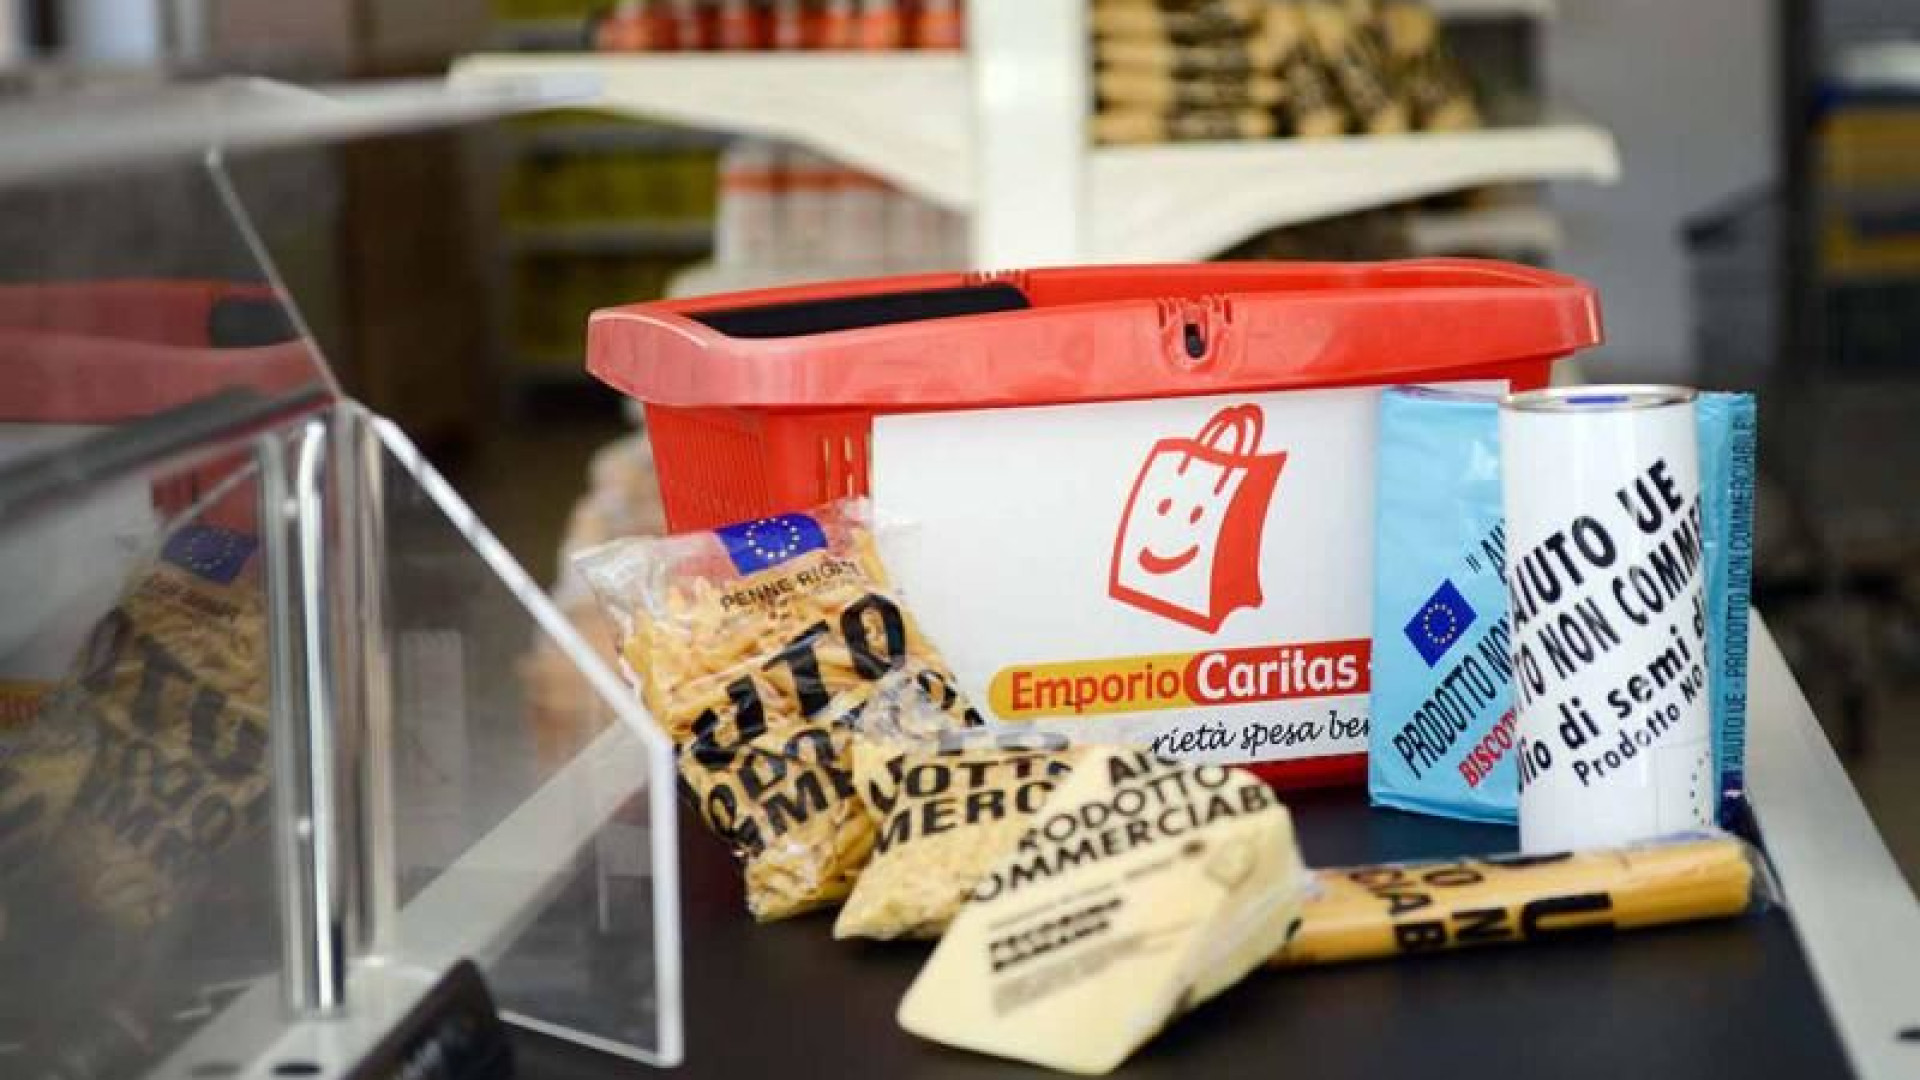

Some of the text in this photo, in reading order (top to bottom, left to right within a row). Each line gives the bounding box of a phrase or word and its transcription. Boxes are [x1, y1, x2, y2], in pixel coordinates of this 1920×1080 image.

[1510, 457, 1683, 633] AIUTO UE
[690, 592, 907, 770] UTO
[1011, 662, 1181, 714] Emporio
[1197, 649, 1360, 700] Caritas
[1536, 596, 1621, 680] NON
[1392, 653, 1497, 780] PRODOTTO
[1559, 696, 1601, 751] di
[1607, 623, 1691, 721] semi
[1240, 719, 1325, 757] spesa
[1458, 705, 1518, 788] BISCOT
[1572, 701, 1681, 788] Prodotto
